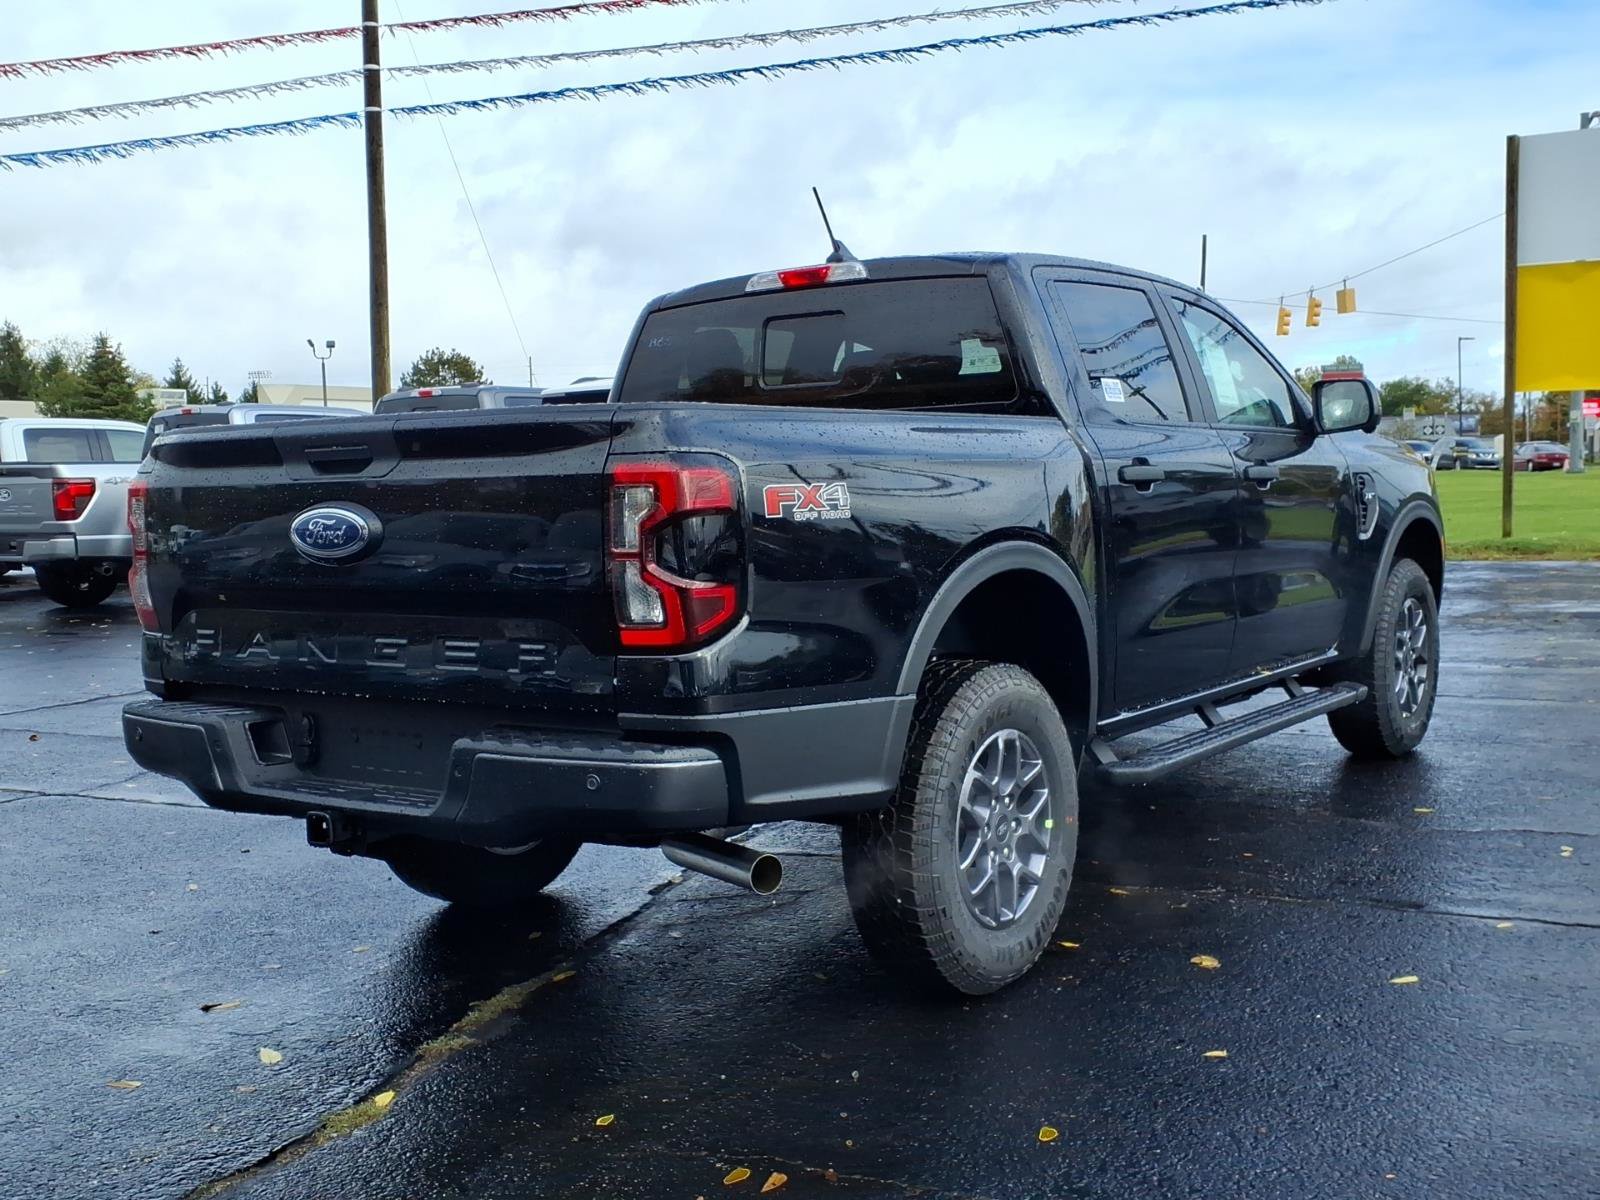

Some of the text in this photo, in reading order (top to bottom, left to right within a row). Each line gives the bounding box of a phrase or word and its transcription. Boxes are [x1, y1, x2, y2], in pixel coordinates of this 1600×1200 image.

[763, 482, 850, 518] FX4
[794, 509, 851, 520] OFF ROAD
[305, 518, 347, 545] Ford
